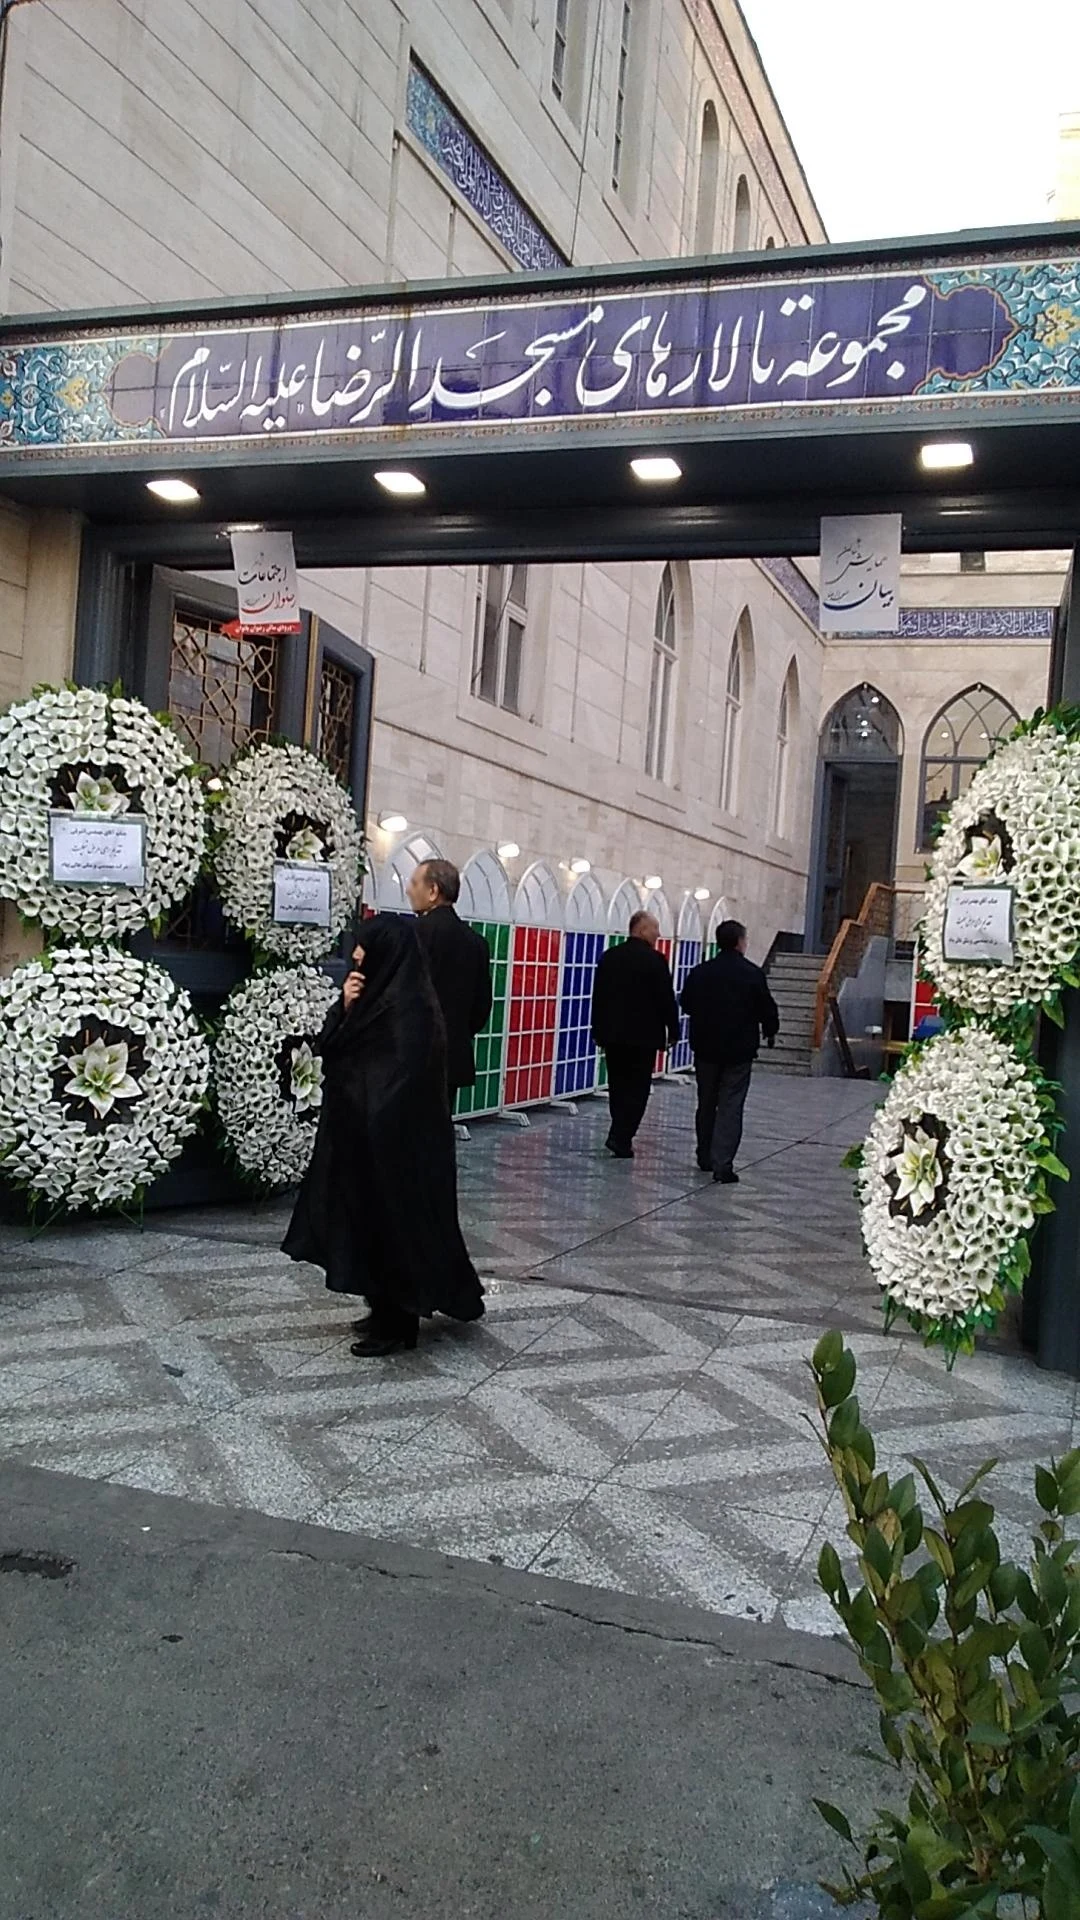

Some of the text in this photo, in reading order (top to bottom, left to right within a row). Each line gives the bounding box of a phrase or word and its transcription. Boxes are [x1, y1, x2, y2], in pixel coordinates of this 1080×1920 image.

[408, 302, 606, 412] مسجد
[575, 294, 816, 409] تالارهای
[238, 564, 287, 585] اجتماعات
[241, 586, 296, 614] رضوان
